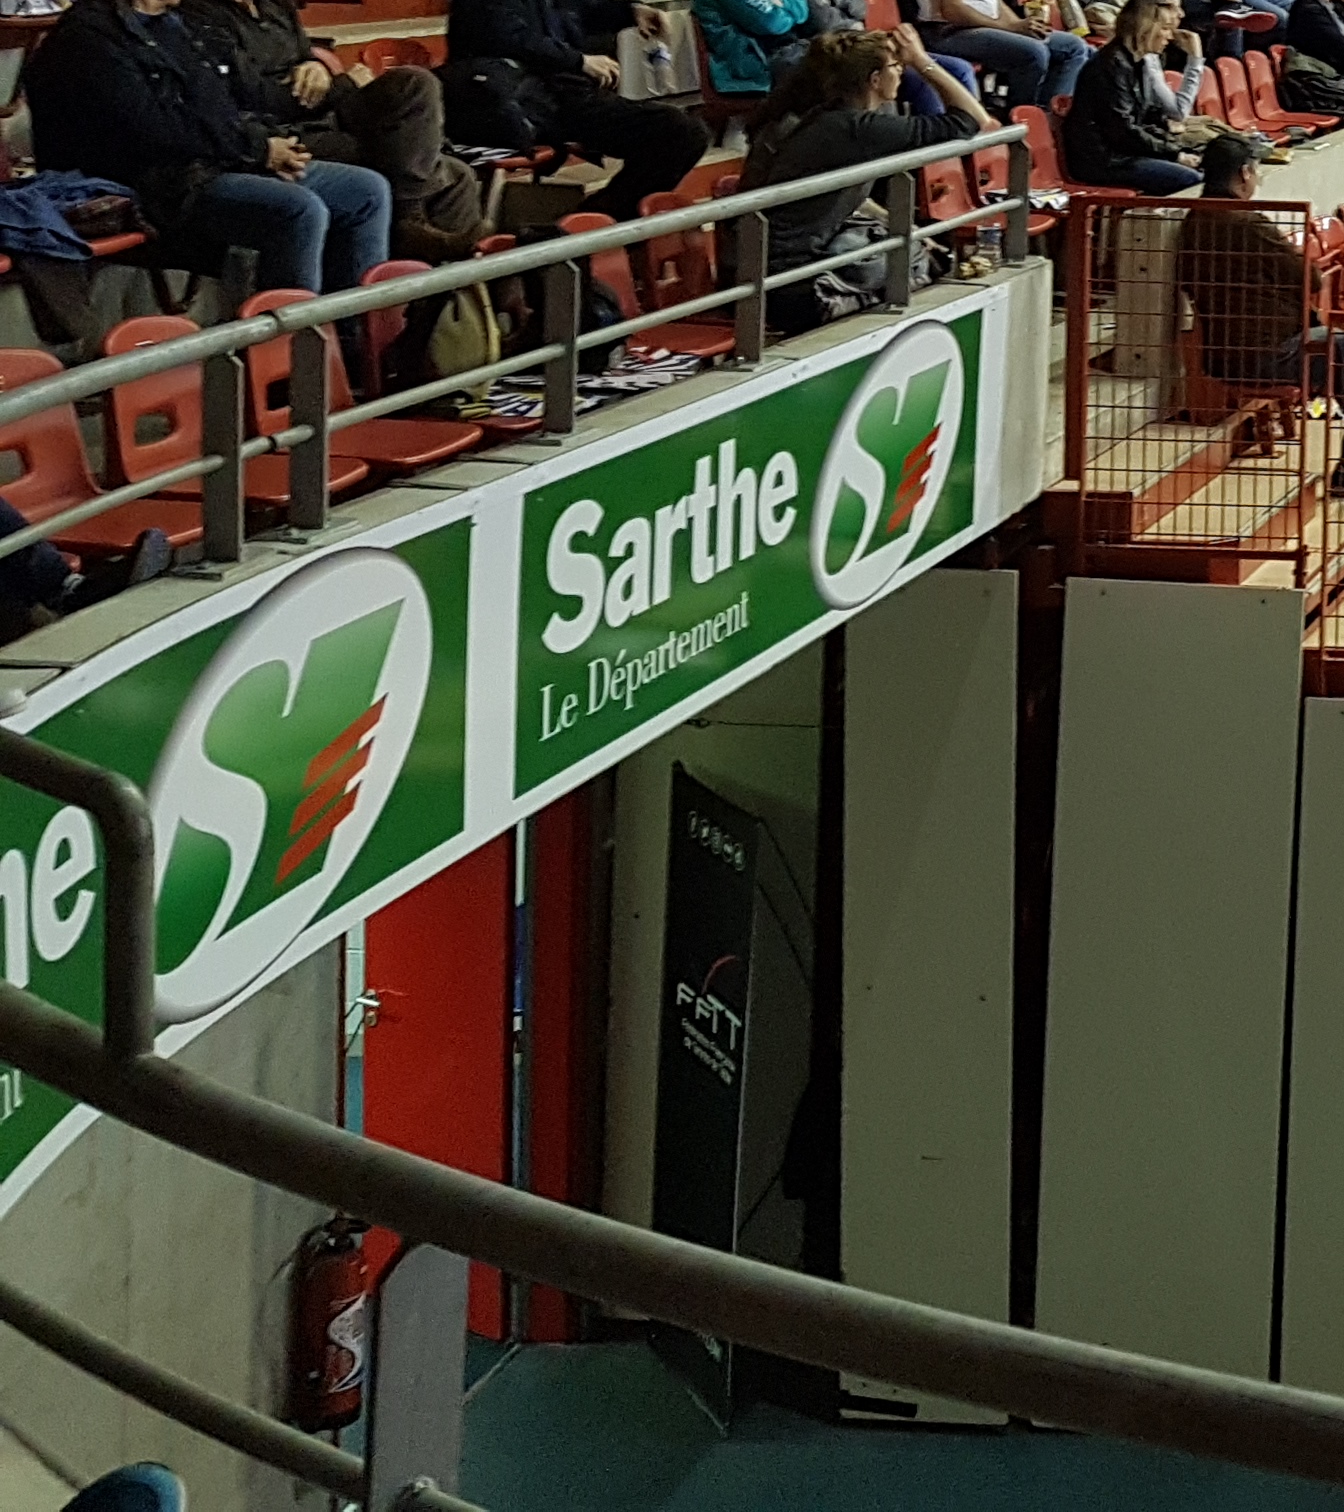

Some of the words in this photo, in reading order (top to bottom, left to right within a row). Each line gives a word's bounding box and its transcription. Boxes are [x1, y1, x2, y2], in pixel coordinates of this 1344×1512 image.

[541, 438, 799, 654] Sarthe
[538, 683, 580, 742] Le
[585, 591, 750, 717] Département
